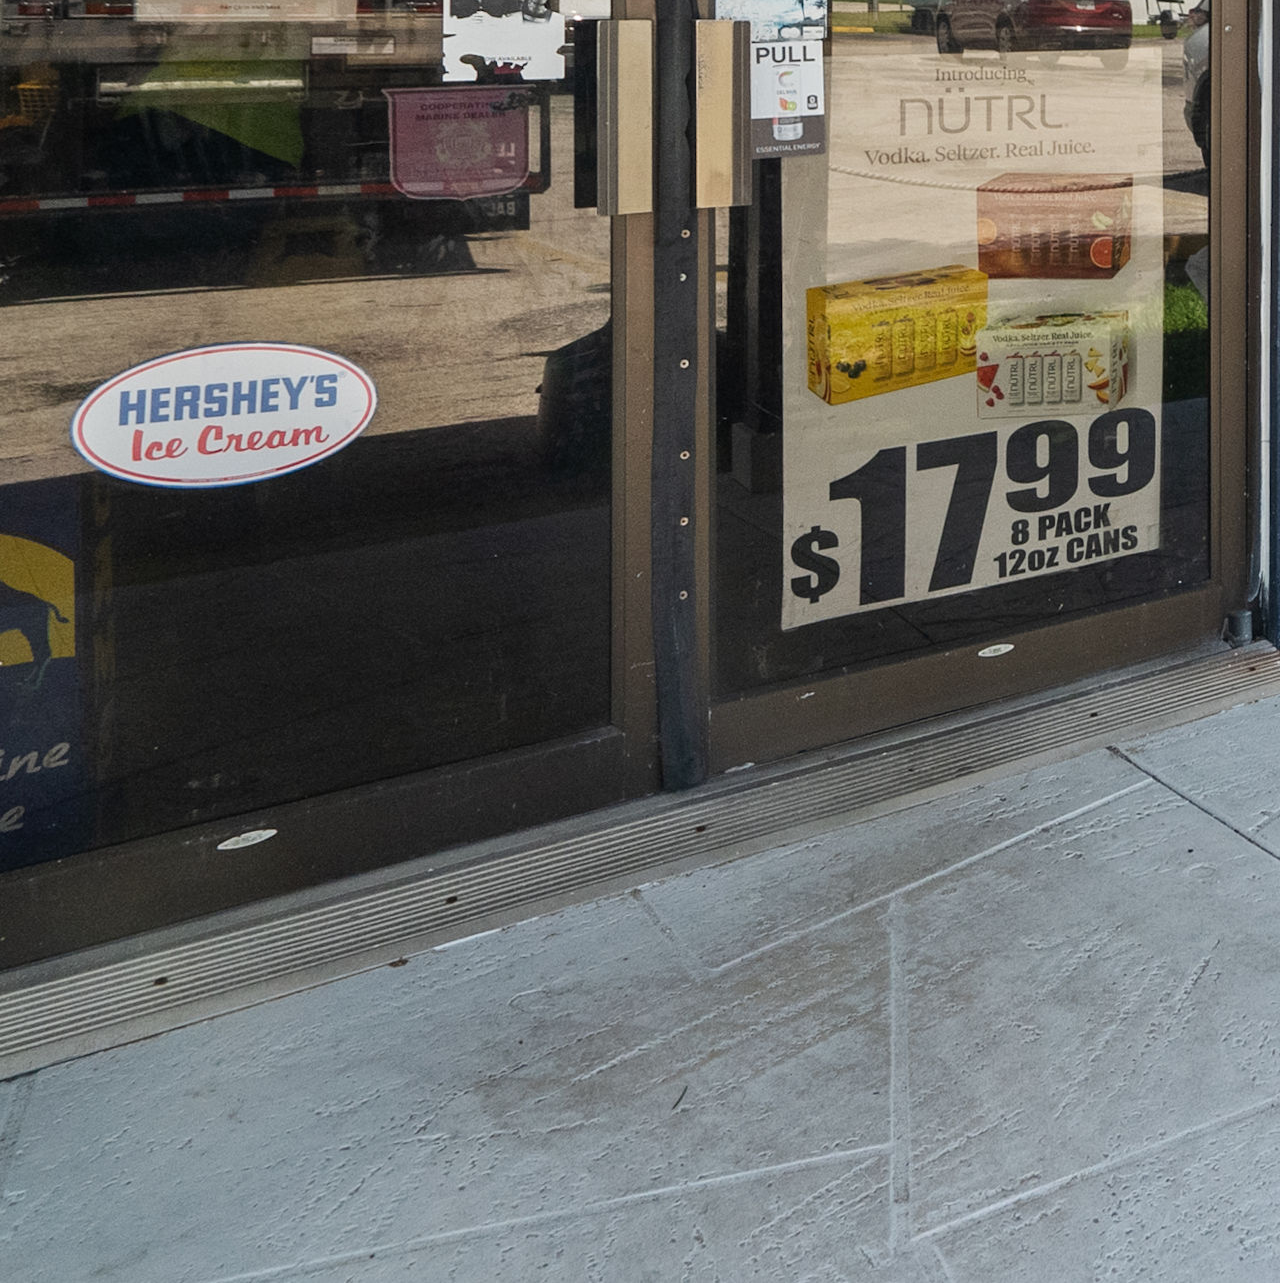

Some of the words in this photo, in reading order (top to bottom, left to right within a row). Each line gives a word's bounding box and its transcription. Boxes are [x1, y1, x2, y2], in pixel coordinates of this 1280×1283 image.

[756, 46, 816, 64] PULL
[935, 66, 1027, 83] Introducing
[756, 144, 792, 154] ESSENTIAL
[793, 142, 820, 151] ENERGY
[864, 147, 931, 166] Vodka.
[934, 145, 1000, 163] Seltzer.
[1005, 140, 1044, 158] Real
[1046, 139, 1096, 157] Juice.
[993, 334, 1020, 343] Vodka.
[1051, 332, 1069, 340] Real
[118, 373, 338, 426] HERSHEY'S
[131, 429, 189, 462] Ice
[197, 424, 329, 456] Cream
[1011, 519, 1030, 545] 8
[1038, 502, 1111, 541] PACK
[993, 548, 1059, 578] 12oz
[1066, 525, 1138, 564] CANS
